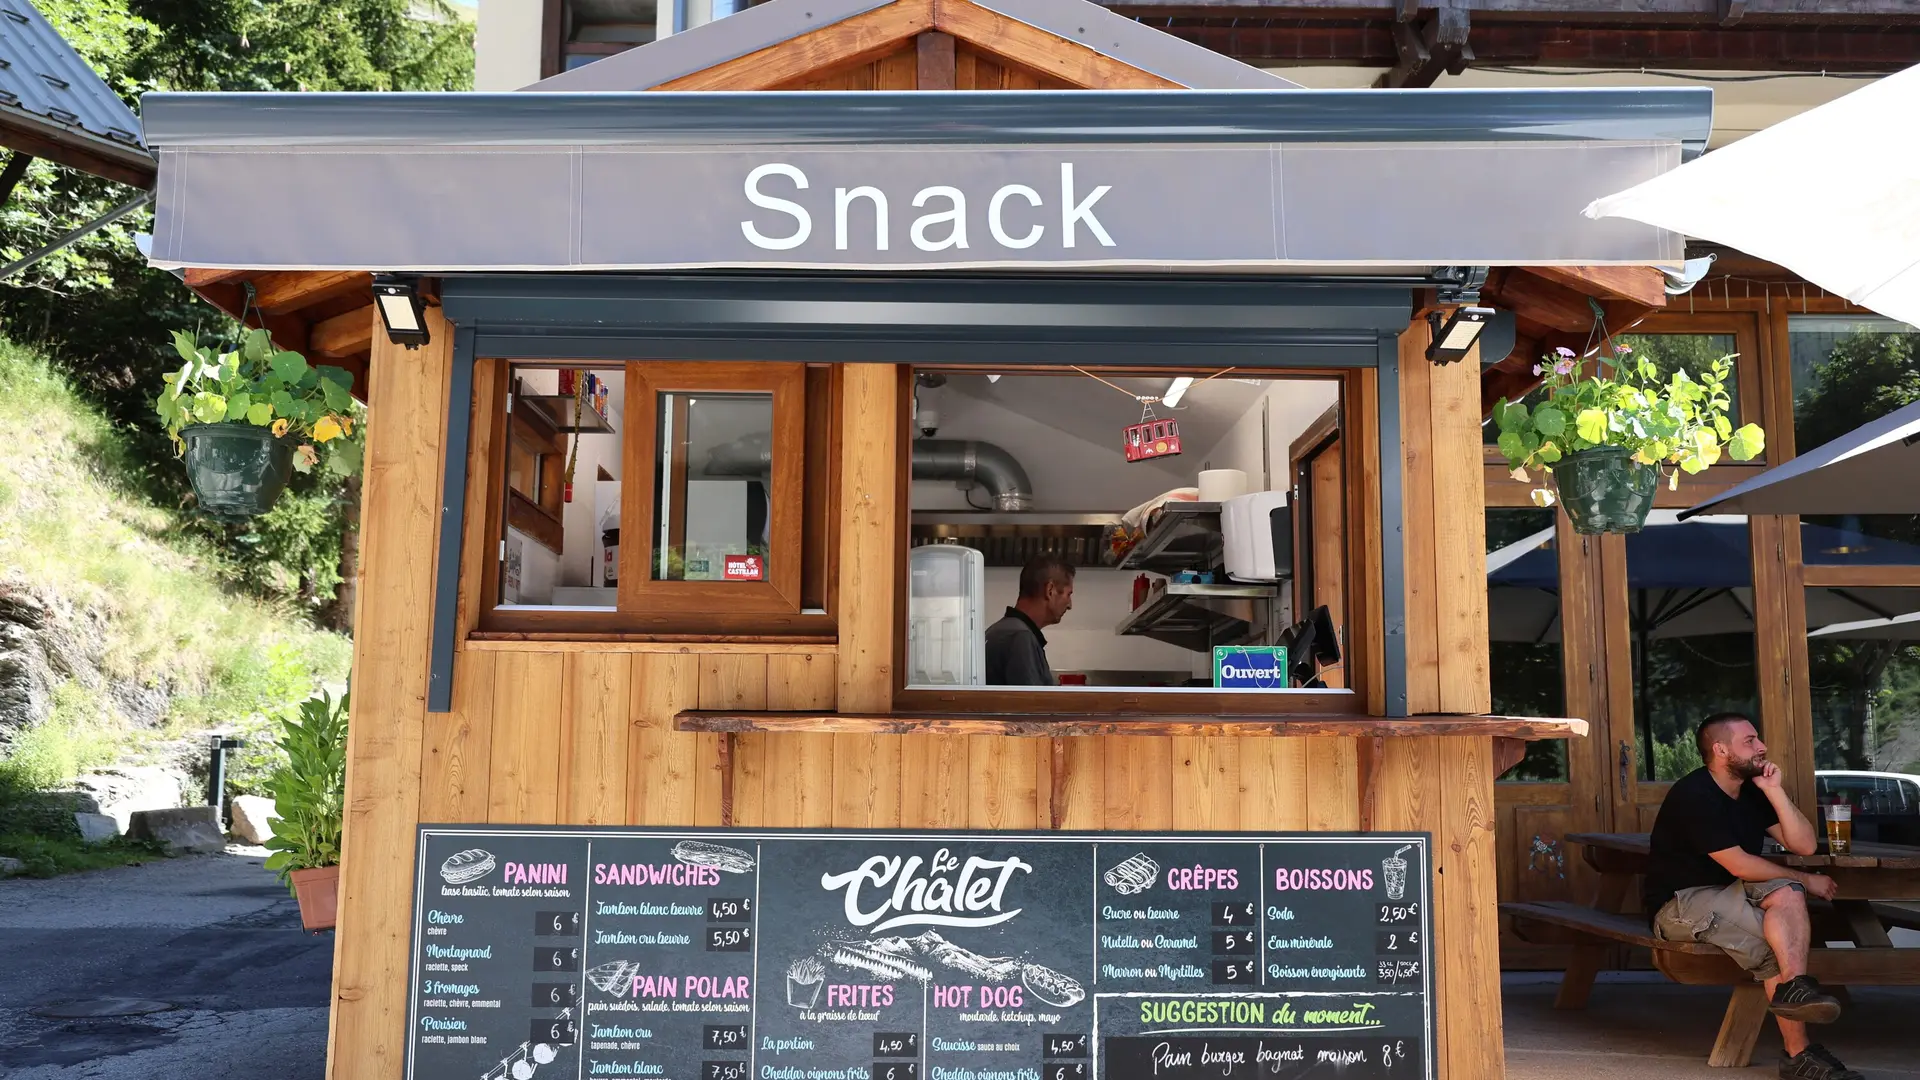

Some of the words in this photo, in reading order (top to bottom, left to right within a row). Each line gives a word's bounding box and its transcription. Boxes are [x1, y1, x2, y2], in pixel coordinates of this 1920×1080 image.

[740, 162, 1117, 251] Snack
[1222, 665, 1280, 678] Ouvert
[930, 848, 960, 877] Le
[504, 862, 567, 884] PANINI
[594, 863, 720, 886] SANDWICHES
[1167, 864, 1239, 890] CRÊPES
[1275, 868, 1374, 890] BOISSONS
[441, 885, 461, 896] base
[492, 886, 521, 897] tomate
[521, 887, 543, 898] selon
[543, 887, 570, 898] saison
[821, 855, 1032, 926] Chalet
[596, 900, 639, 916] Jambon
[640, 901, 669, 915] blanc
[670, 901, 703, 916] beurre
[1102, 906, 1132, 919] Sucre
[1133, 910, 1146, 919] ou
[1147, 906, 1180, 919] beurre
[1223, 906, 1233, 924] 4
[1267, 906, 1294, 920] Soda
[428, 910, 464, 924] Chèvre
[554, 916, 561, 930] 6
[428, 927, 447, 935] chèvre
[594, 929, 637, 945] Jambon
[639, 934, 656, 944] cru
[657, 931, 691, 945] beurre
[1102, 935, 1140, 949] Nutella
[1141, 939, 1153, 949] ou
[1154, 935, 1198, 949] Caramel
[1226, 935, 1236, 950] 5
[1268, 935, 1289, 949] Eau
[1290, 936, 1333, 949] minérale
[1387, 934, 1398, 950] 2
[426, 944, 492, 961] Montagnard
[552, 951, 561, 966] 6
[426, 963, 449, 972] raclette,
[451, 963, 468, 972] speck
[1102, 964, 1143, 978] Marron
[1145, 968, 1157, 978] ou
[1158, 964, 1204, 981] Myrtilles
[1227, 965, 1237, 980] 5
[1268, 964, 1310, 978] Boisson
[1311, 964, 1366, 981] énergisante
[423, 980, 432, 993] 3
[433, 980, 480, 997] fromages
[632, 975, 678, 998] PAIN
[685, 976, 749, 998] POLAR
[550, 988, 560, 1002] 6
[828, 984, 894, 1007] FRITES
[934, 984, 972, 1008] HOT
[980, 985, 1024, 1008] DOG
[424, 999, 448, 1008] raclette,
[472, 1000, 500, 1008] emmental
[587, 1002, 608, 1015] pain
[672, 1001, 700, 1012] tomate
[701, 1001, 723, 1012] selon
[723, 1002, 750, 1012] saison
[800, 1010, 806, 1020] à
[807, 1010, 816, 1020] la
[817, 1011, 846, 1023] graisse
[847, 1011, 857, 1021] de
[1038, 1013, 1061, 1024] mayo
[1140, 1001, 1264, 1024] SUGGESTION
[1272, 1002, 1296, 1024] du
[421, 1016, 467, 1031] Parisien
[591, 1023, 635, 1038] Jambon
[635, 1028, 652, 1038] cru
[550, 1024, 560, 1039] 6
[422, 1035, 446, 1044] raclette,
[447, 1035, 470, 1044] jambon
[471, 1036, 487, 1044] blanc
[591, 1041, 619, 1050] tapenade,
[620, 1041, 640, 1050] chèvre
[761, 1036, 777, 1050] La
[777, 1037, 814, 1055] portion
[932, 1037, 976, 1051] Saucisse
[1004, 1042, 1020, 1051] choix
[1152, 1042, 1192, 1075] Pain
[1201, 1043, 1246, 1076] burger
[1256, 1041, 1305, 1073] bagnat
[589, 1059, 633, 1074] Jambon
[633, 1060, 664, 1074] blanc
[761, 1065, 805, 1080] Cheddar
[807, 1068, 846, 1080] oignons
[846, 1066, 870, 1080] frits
[886, 1067, 895, 1080] 6
[931, 1066, 976, 1080] Cheddar
[1016, 1068, 1040, 1080] frits
[1056, 1067, 1065, 1080] 6
